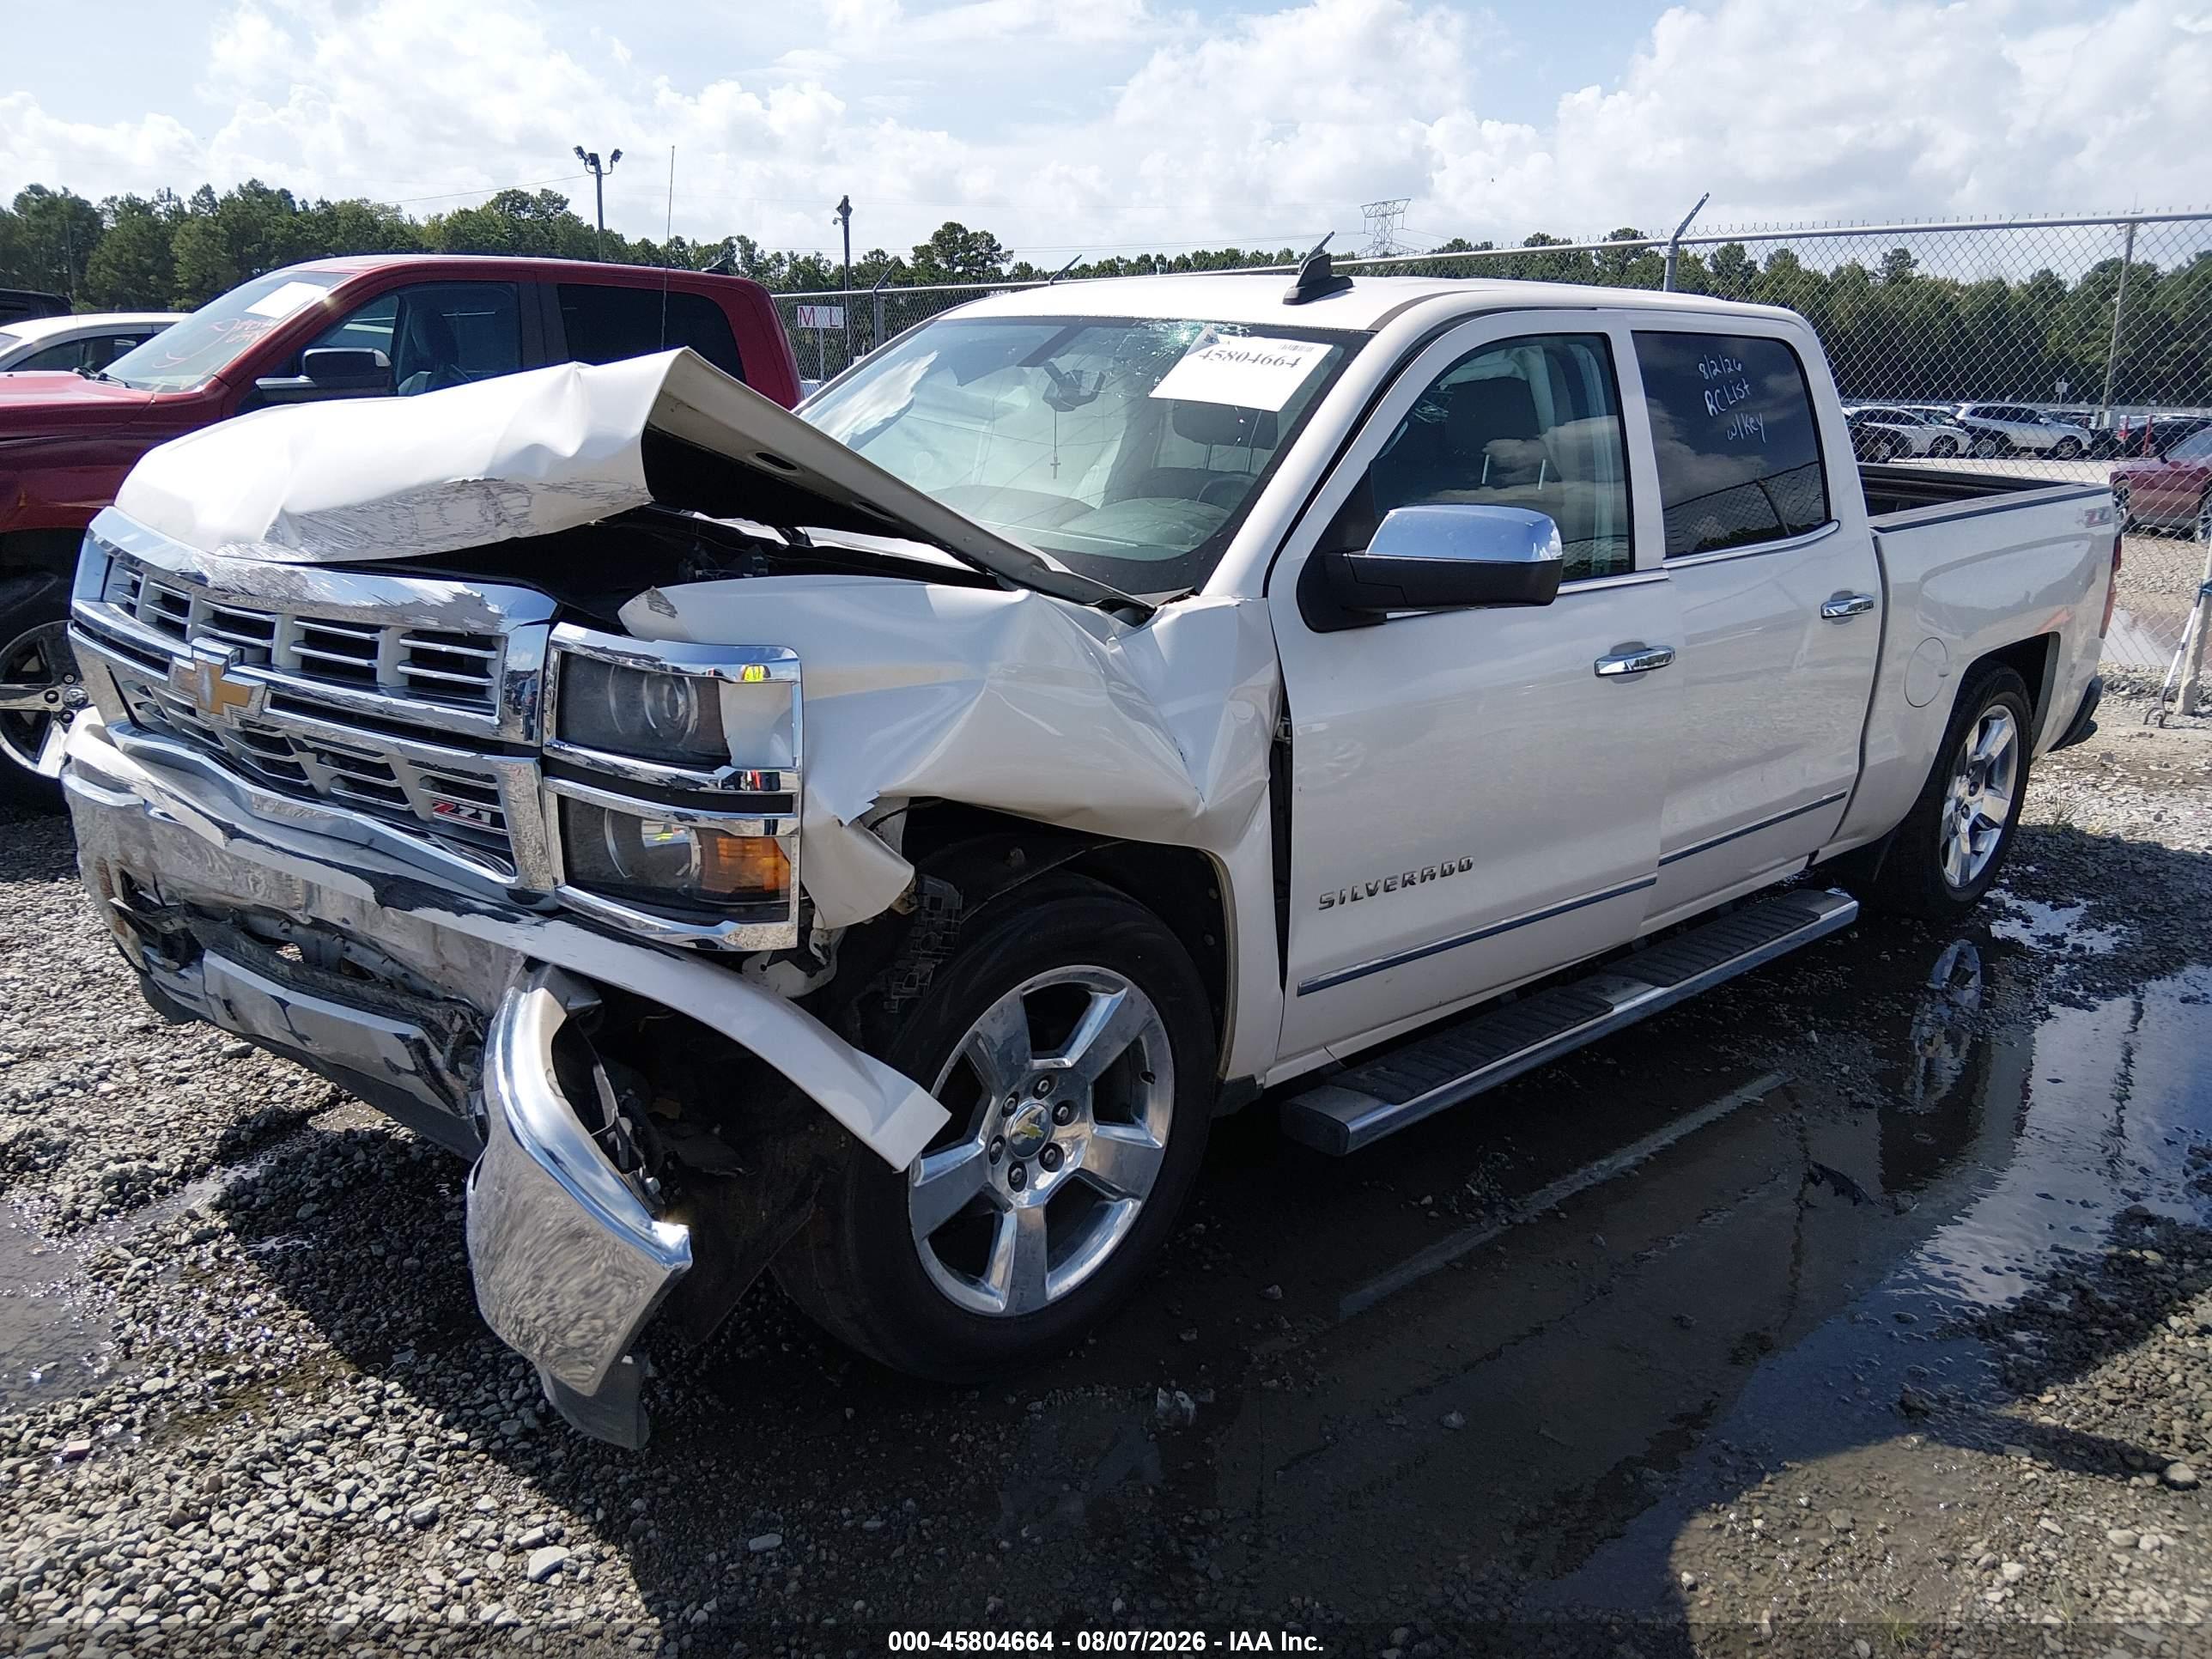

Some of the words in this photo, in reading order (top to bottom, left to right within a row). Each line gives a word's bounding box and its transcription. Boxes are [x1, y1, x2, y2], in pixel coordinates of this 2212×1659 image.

[799, 307, 816, 326] M
[829, 308, 839, 327] L
[1199, 348, 1302, 368] 45804664
[1698, 354, 1742, 380] 8/2/26
[1318, 855, 1474, 910] SILVERADO
